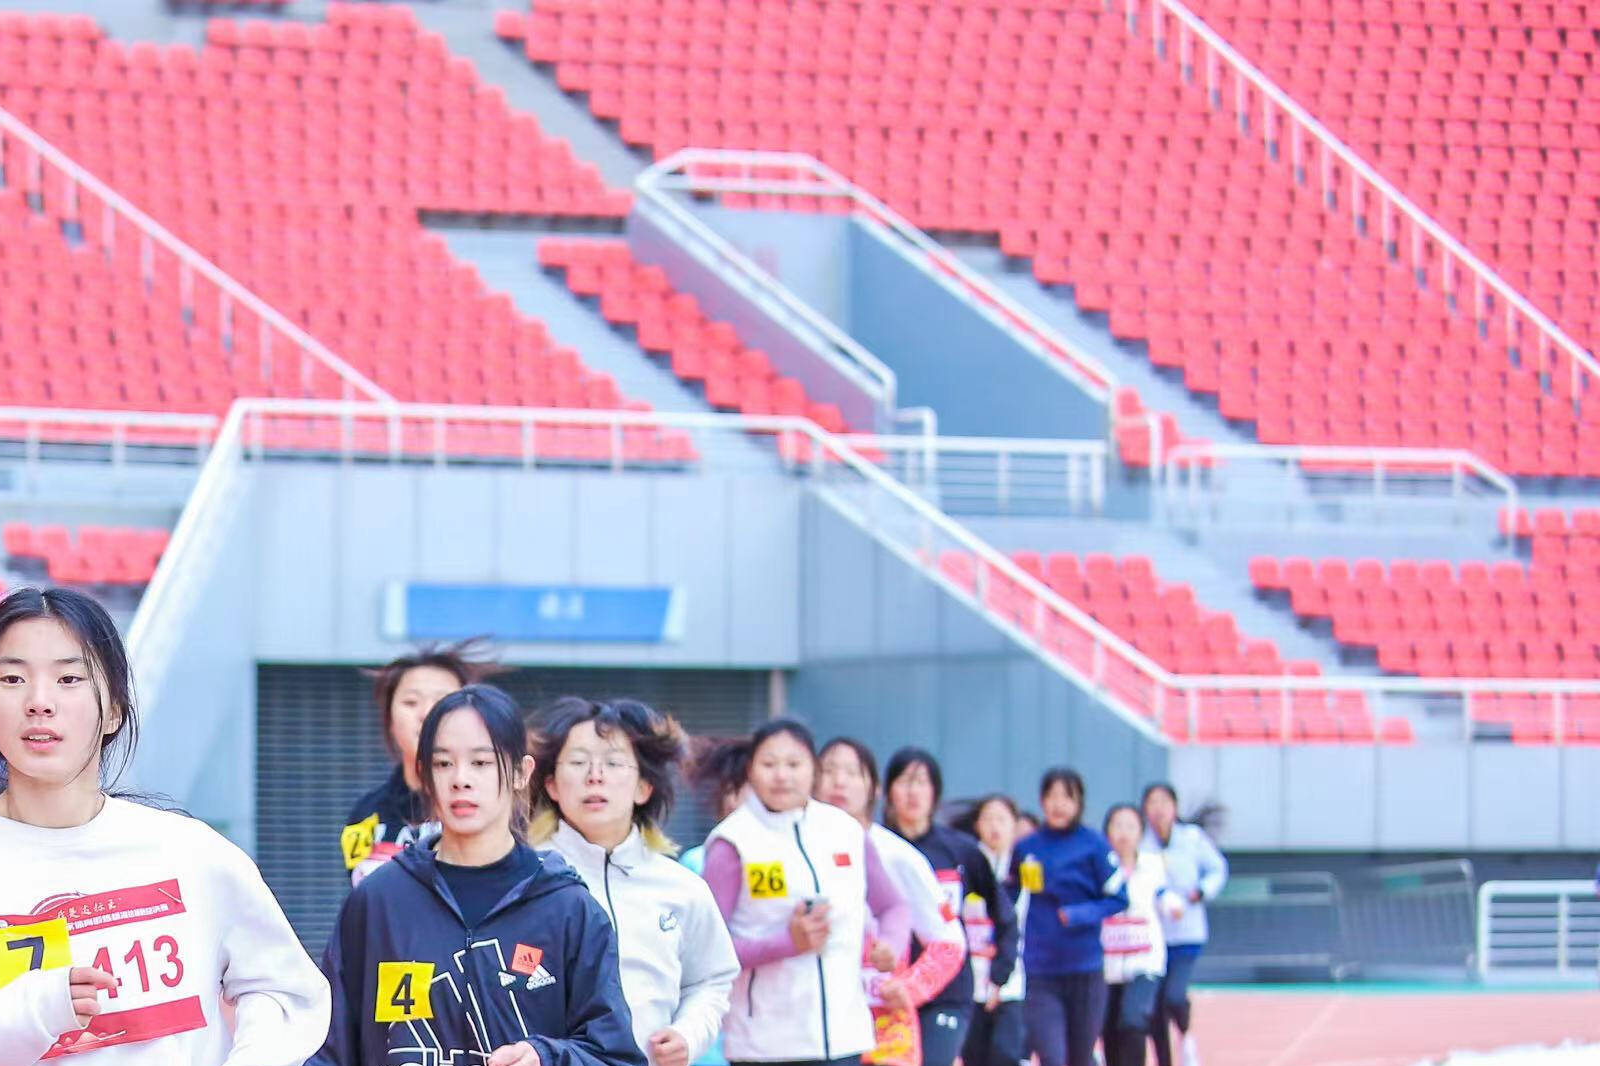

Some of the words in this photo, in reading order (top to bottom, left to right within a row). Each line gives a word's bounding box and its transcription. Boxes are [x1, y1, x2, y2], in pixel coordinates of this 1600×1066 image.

[751, 864, 785, 894] 26
[6, 935, 45, 972] 7
[91, 934, 185, 999] 413
[390, 972, 416, 1015] 4
